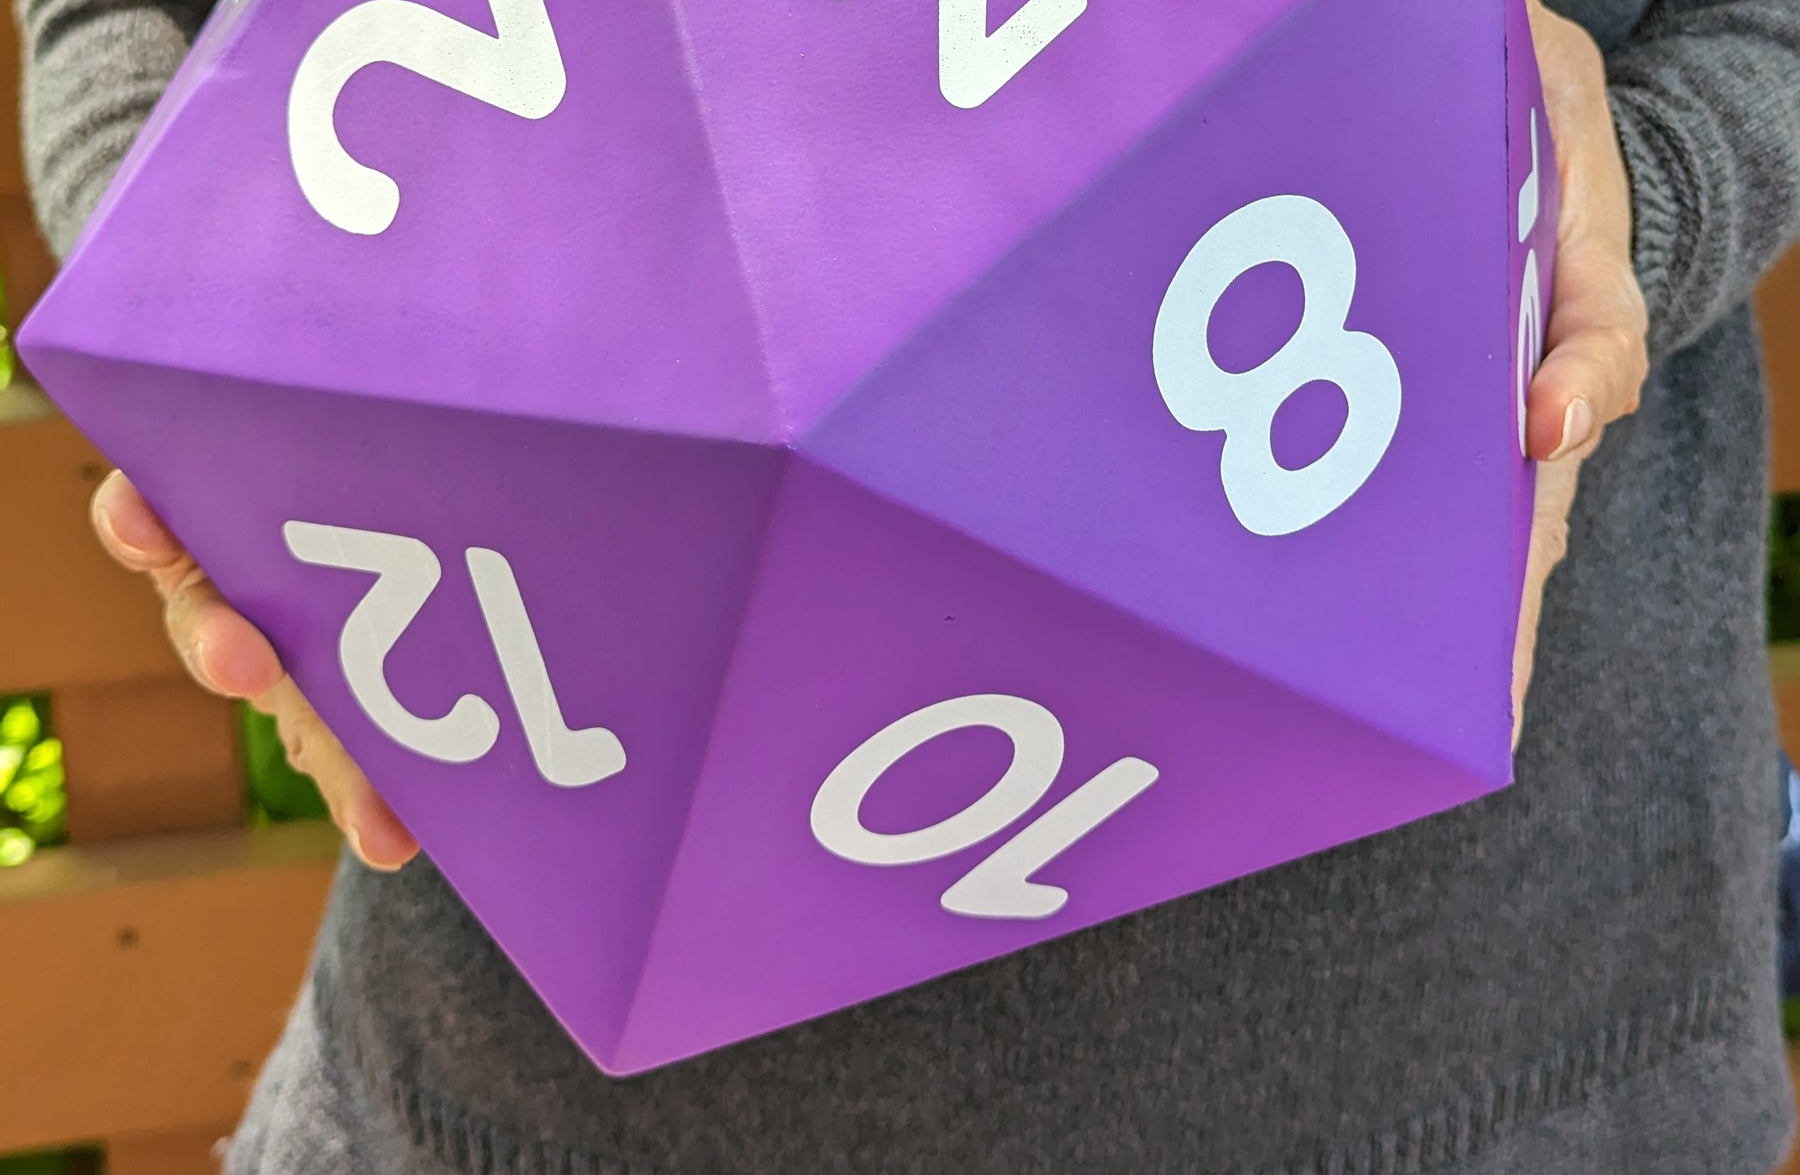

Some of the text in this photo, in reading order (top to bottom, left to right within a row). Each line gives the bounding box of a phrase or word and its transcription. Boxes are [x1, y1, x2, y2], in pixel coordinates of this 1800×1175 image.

[1153, 195, 1404, 536] 8
[283, 521, 627, 787] 12
[810, 693, 1160, 918] 10
